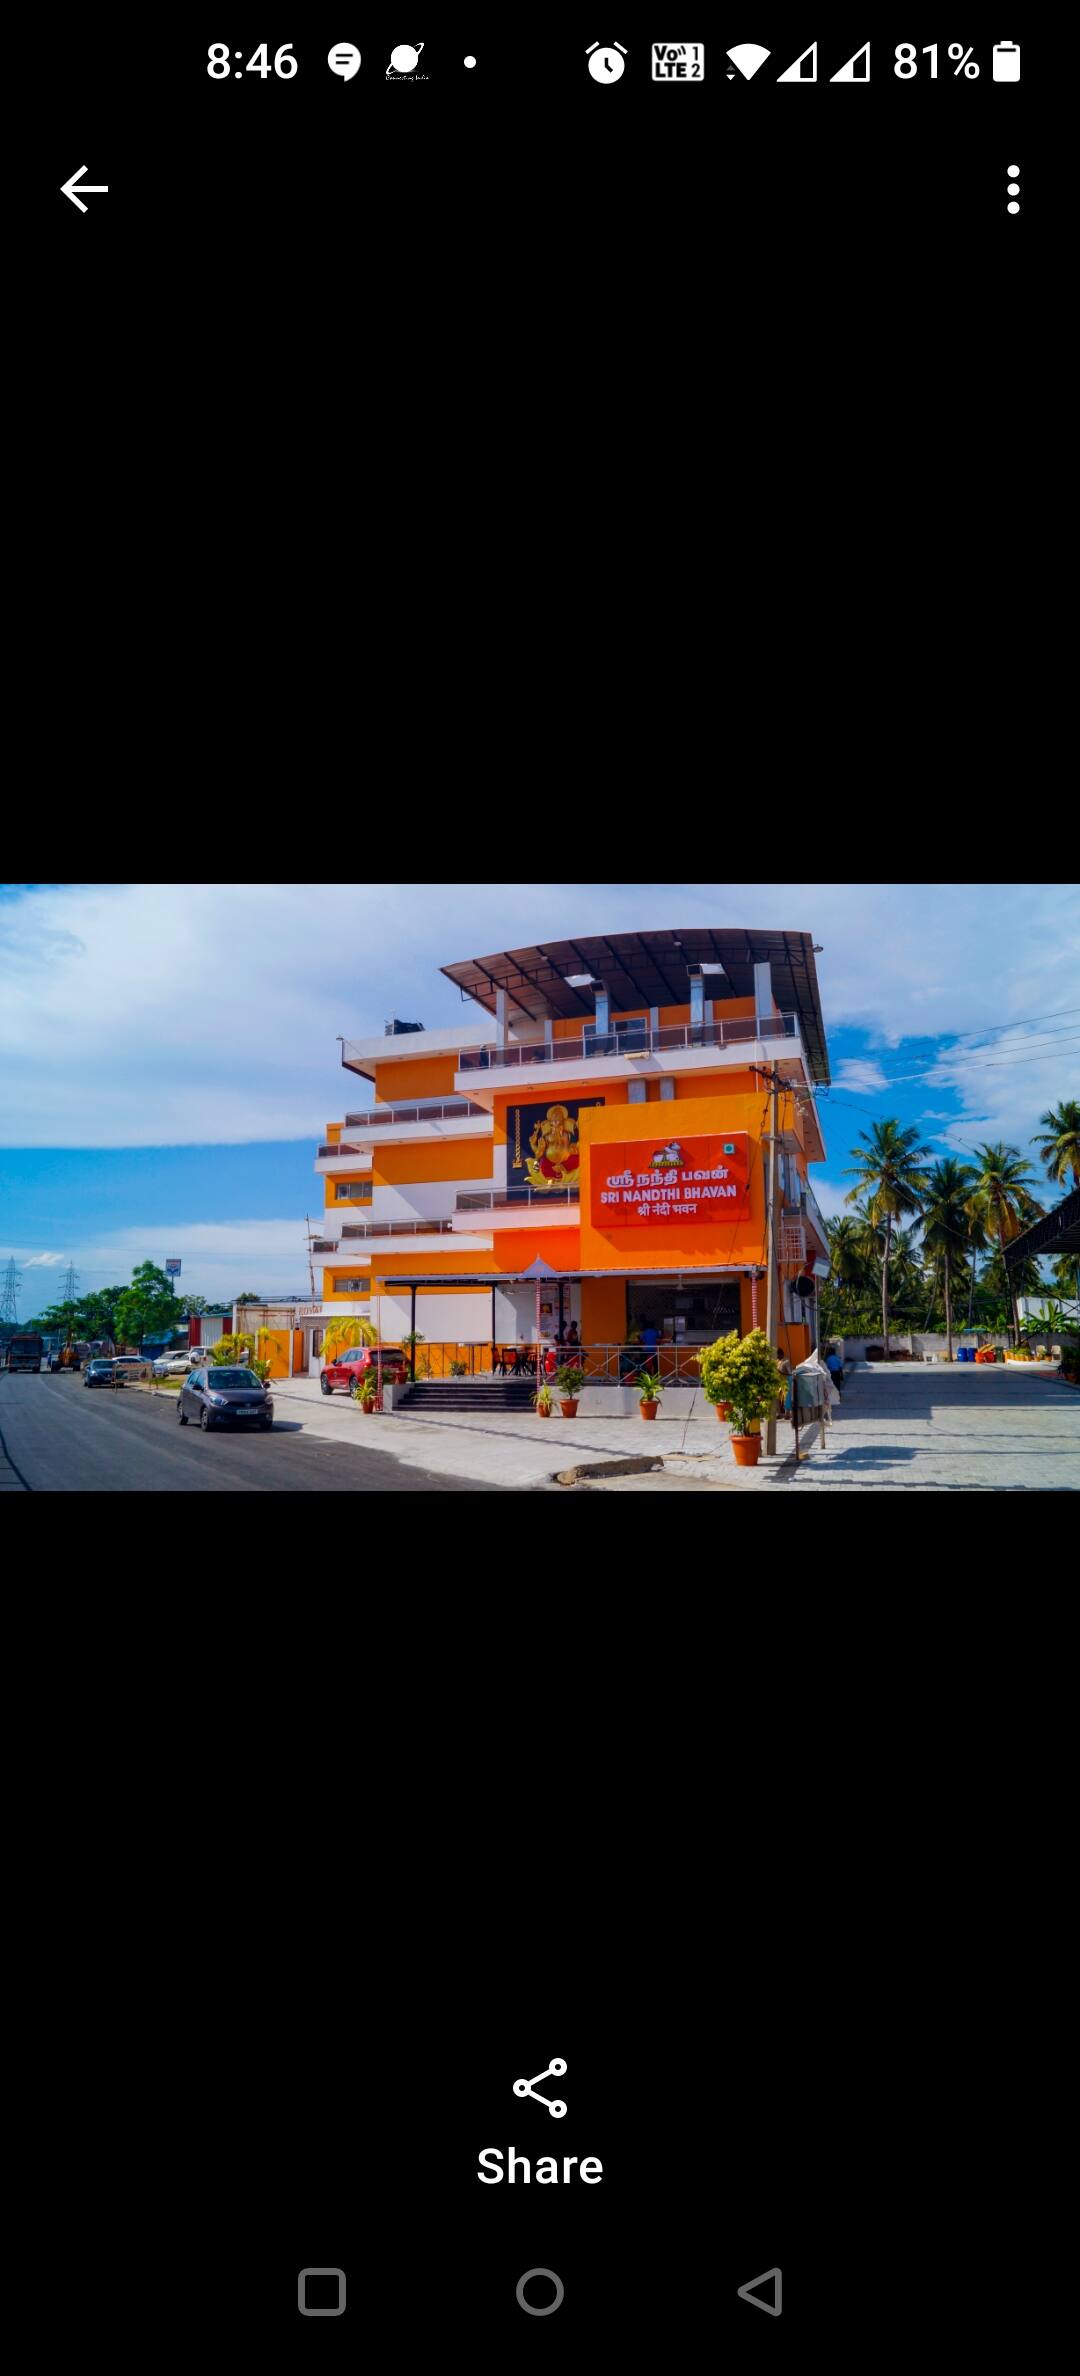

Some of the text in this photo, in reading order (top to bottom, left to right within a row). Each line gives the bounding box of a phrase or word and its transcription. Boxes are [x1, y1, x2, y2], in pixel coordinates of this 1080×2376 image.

[682, 1165, 728, 1181] பவன்
[600, 1185, 737, 1204] SRI NANDTHI BHAVAN
[638, 1203, 697, 1217] श्री नंदी भवन
